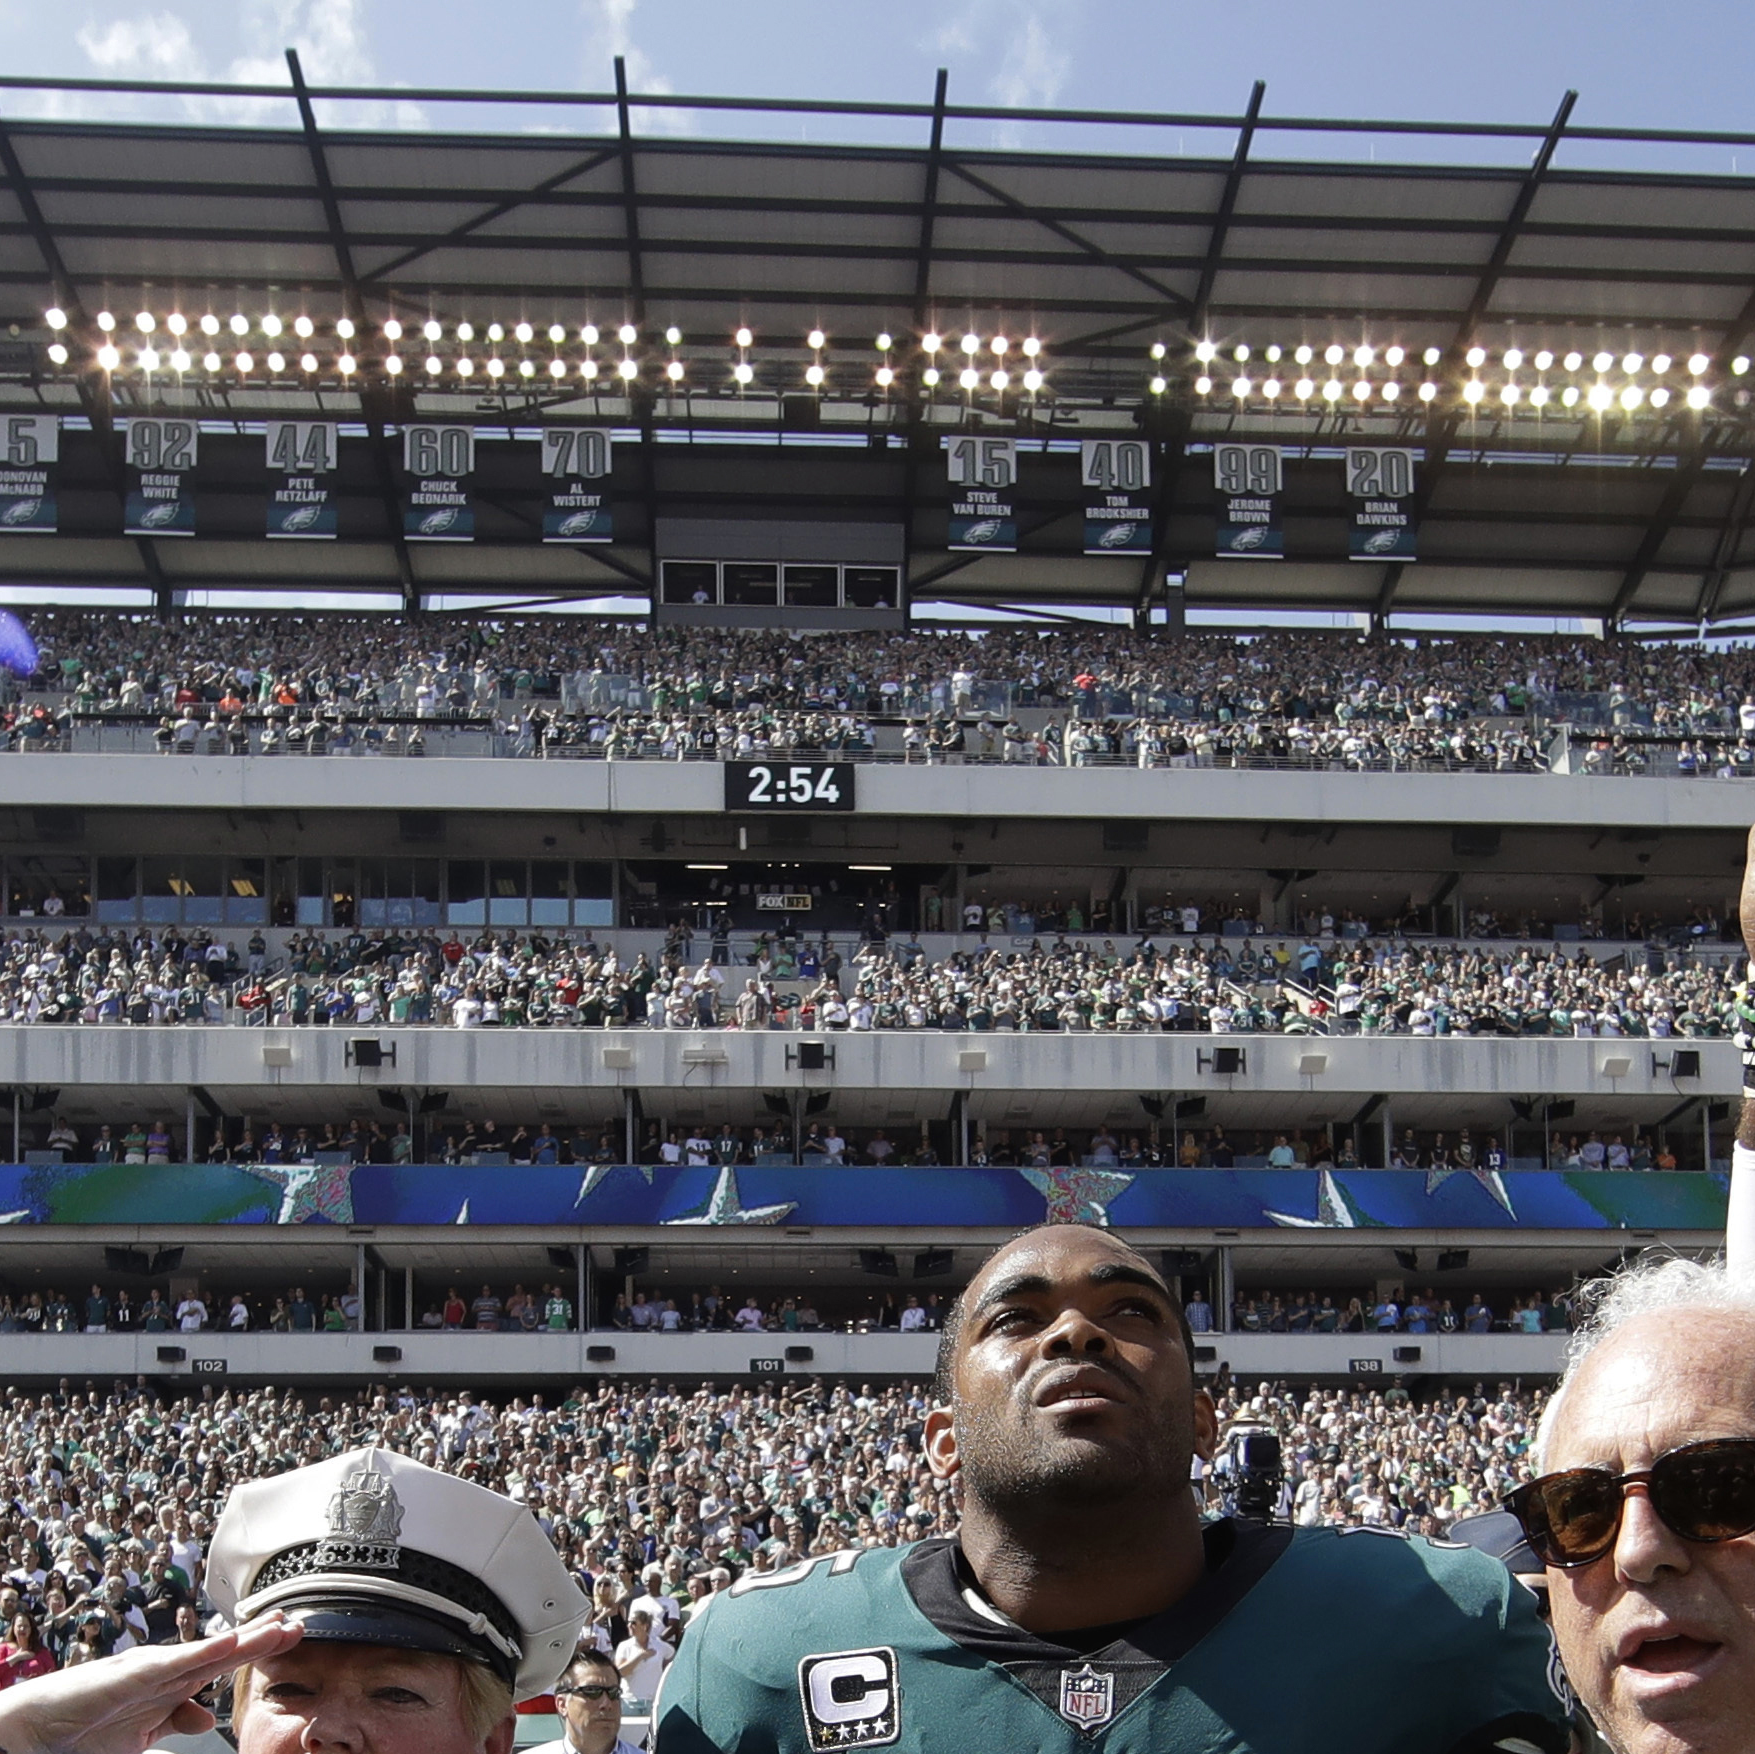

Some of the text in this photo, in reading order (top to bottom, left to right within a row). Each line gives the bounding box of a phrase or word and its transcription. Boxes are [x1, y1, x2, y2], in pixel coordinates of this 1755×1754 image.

[7, 417, 38, 467] 5
[131, 420, 193, 471] 92
[271, 423, 331, 475] 44
[409, 427, 470, 477] 60
[548, 430, 606, 479] 70
[954, 439, 1011, 489] 15
[1088, 442, 1144, 491] 40
[1219, 446, 1278, 496] 99
[1351, 450, 1409, 498] 20
[140, 474, 181, 488] REGGIE
[288, 478, 315, 491] PETE
[420, 480, 458, 493] CHUCK
[141, 487, 179, 500] WHITE
[570, 482, 584, 495] AL
[275, 490, 328, 503] RETZLAFF
[411, 492, 467, 506] BEDNARIK
[553, 494, 602, 508] WISTERT
[966, 491, 998, 504] STEVE
[1106, 496, 1129, 508] TOM
[952, 503, 1012, 517] VAN BUREN
[1227, 499, 1271, 511] JEROME
[1364, 501, 1399, 514] BRIAN
[1085, 507, 1150, 520] BROOKSHIER
[1229, 511, 1270, 523] BROWN
[1356, 513, 1408, 526] DAWKINS
[748, 766, 840, 804] 2:54
[758, 895, 811, 910] FOX NFL
[720, 1140, 732, 1152] 17
[1489, 1153, 1501, 1166] 13
[118, 1308, 130, 1321] 11
[552, 1303, 564, 1315] 31
[195, 1360, 224, 1373] 102
[756, 1359, 779, 1372] 101
[1352, 1359, 1379, 1372] 138
[323, 1540, 393, 1567] 6333
[809, 1655, 891, 1727] C
[1069, 1692, 1106, 1716] NFL
